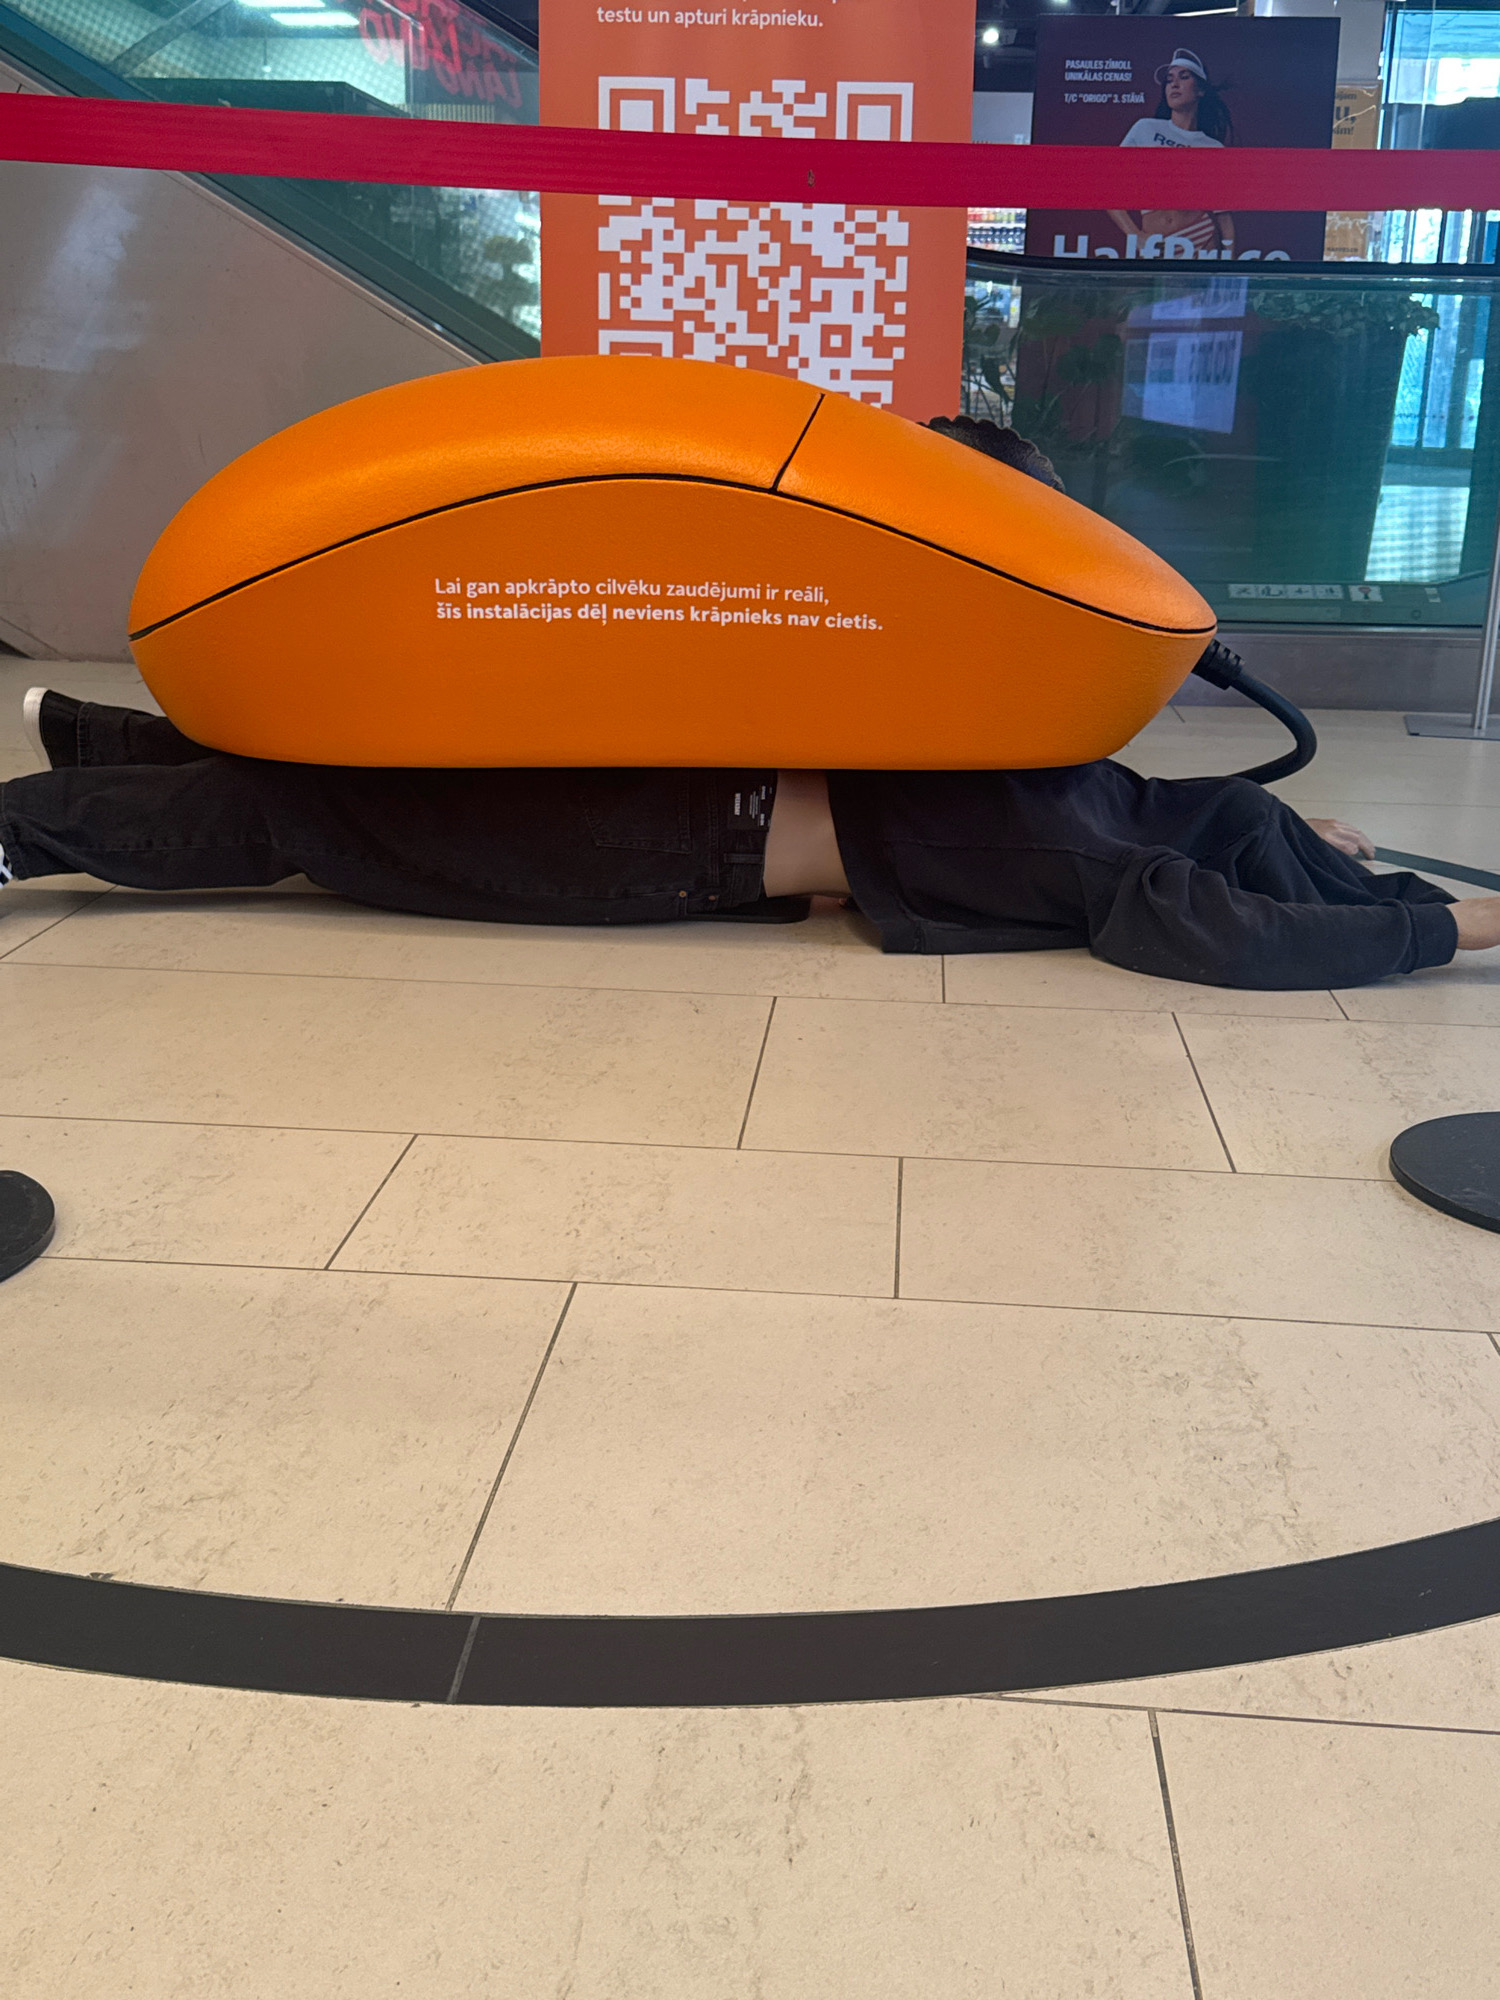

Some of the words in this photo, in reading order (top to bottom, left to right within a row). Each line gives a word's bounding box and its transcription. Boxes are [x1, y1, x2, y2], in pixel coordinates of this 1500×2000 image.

[597, 7, 643, 23] testu
[648, 10, 670, 23] un
[674, 8, 727, 28] apturi
[732, 9, 824, 29] krāpnieku.
[1065, 60, 1103, 70] PASAULES
[1064, 70, 1103, 81] UNIKĀLAS
[1104, 72, 1132, 82] CENAS!
[1064, 93, 1077, 104] T/C
[1121, 92, 1145, 104] STĀVĀ
[435, 577, 461, 595] Lai
[466, 581, 500, 599] gan
[504, 578, 591, 599] apkrāpto
[595, 578, 661, 597] cilvēku
[666, 582, 761, 602] zaudējumi
[765, 584, 779, 600] ir
[784, 586, 830, 606] reāli,
[437, 601, 462, 619] šīs
[467, 603, 573, 624] instalācijas
[577, 603, 608, 626] dēļ
[613, 604, 685, 622] neviens
[690, 605, 783, 627] krāpnieks
[787, 613, 821, 627] nav
[825, 612, 884, 631] cietis.
